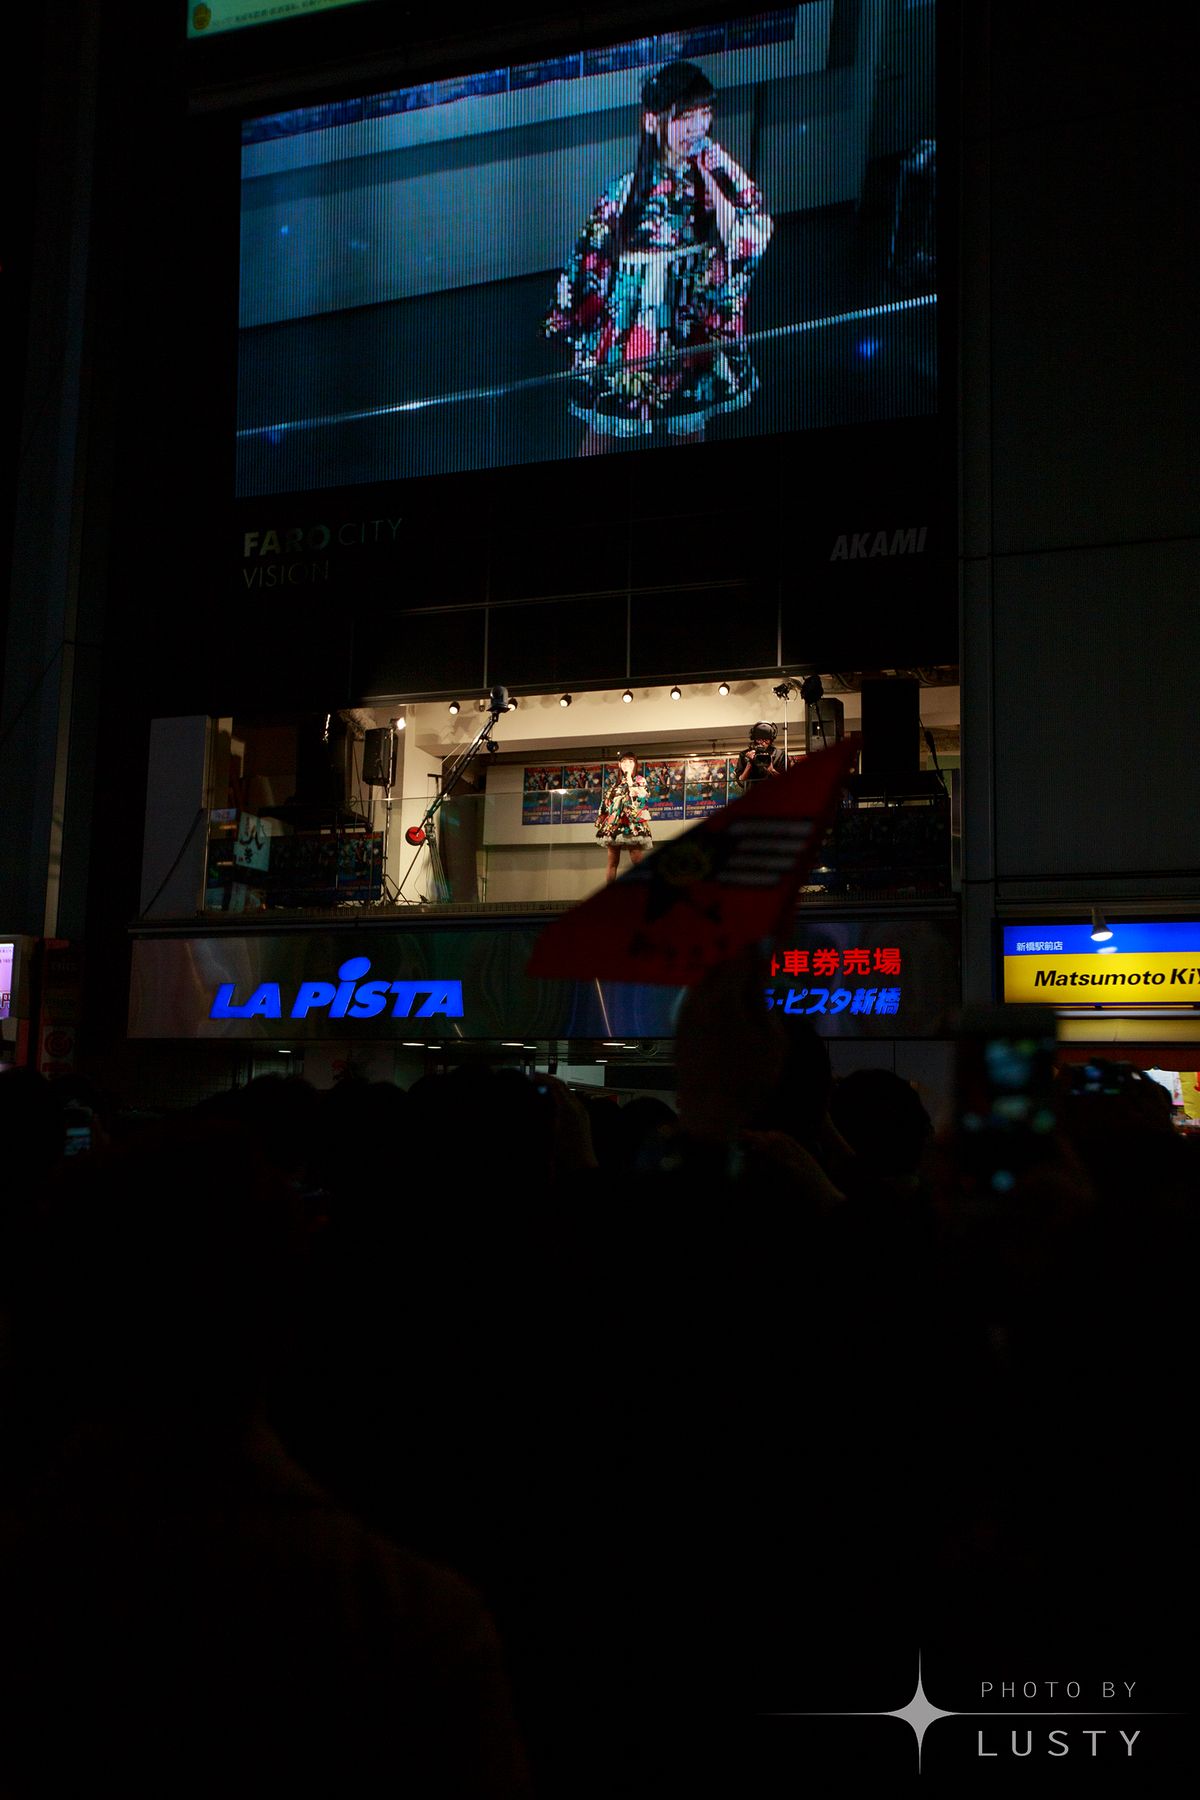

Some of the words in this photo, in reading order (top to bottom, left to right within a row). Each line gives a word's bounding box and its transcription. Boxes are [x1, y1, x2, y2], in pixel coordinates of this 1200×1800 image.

[243, 524, 331, 558] FARO
[338, 516, 403, 546] CITY
[829, 526, 928, 562] AKAMI
[243, 559, 329, 590] VISION
[1016, 941, 1063, 952] 新橋駅前店
[1034, 969, 1166, 987] Matsumoto
[208, 982, 283, 1019] LA
